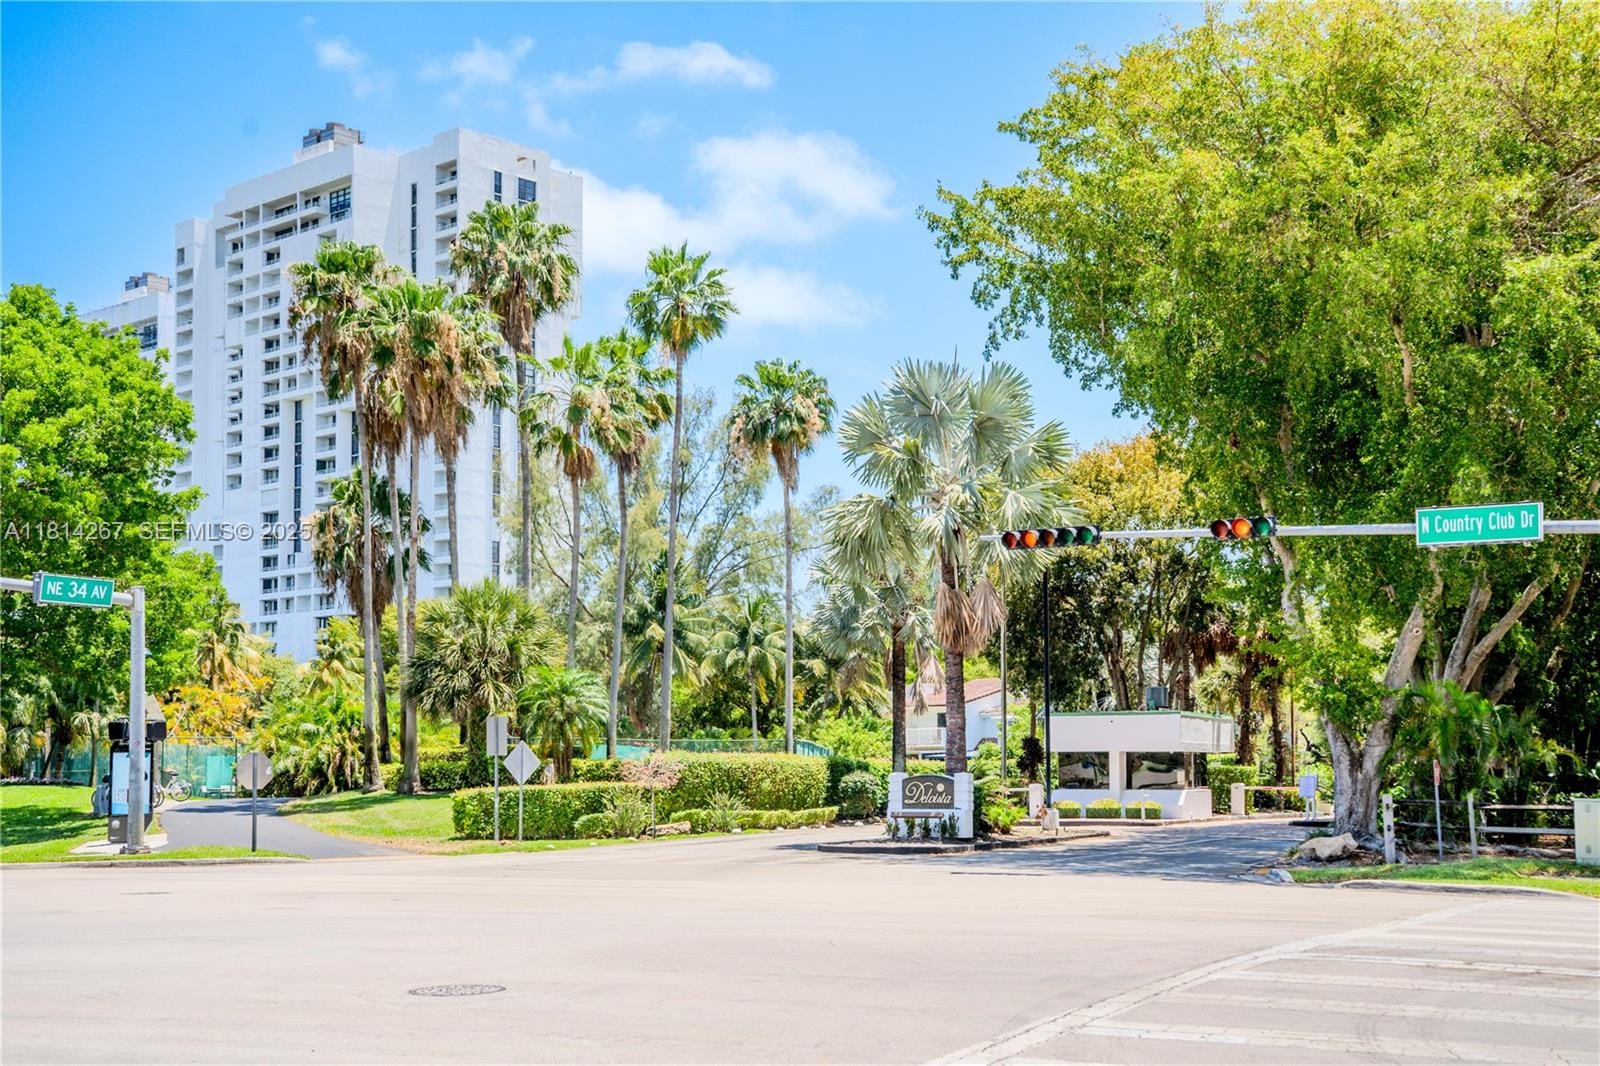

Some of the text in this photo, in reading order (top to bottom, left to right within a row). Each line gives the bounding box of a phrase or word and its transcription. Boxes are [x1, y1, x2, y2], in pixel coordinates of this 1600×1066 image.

[1421, 510, 1535, 535] N Country Club Dr
[46, 580, 108, 600] NE 34 AV
